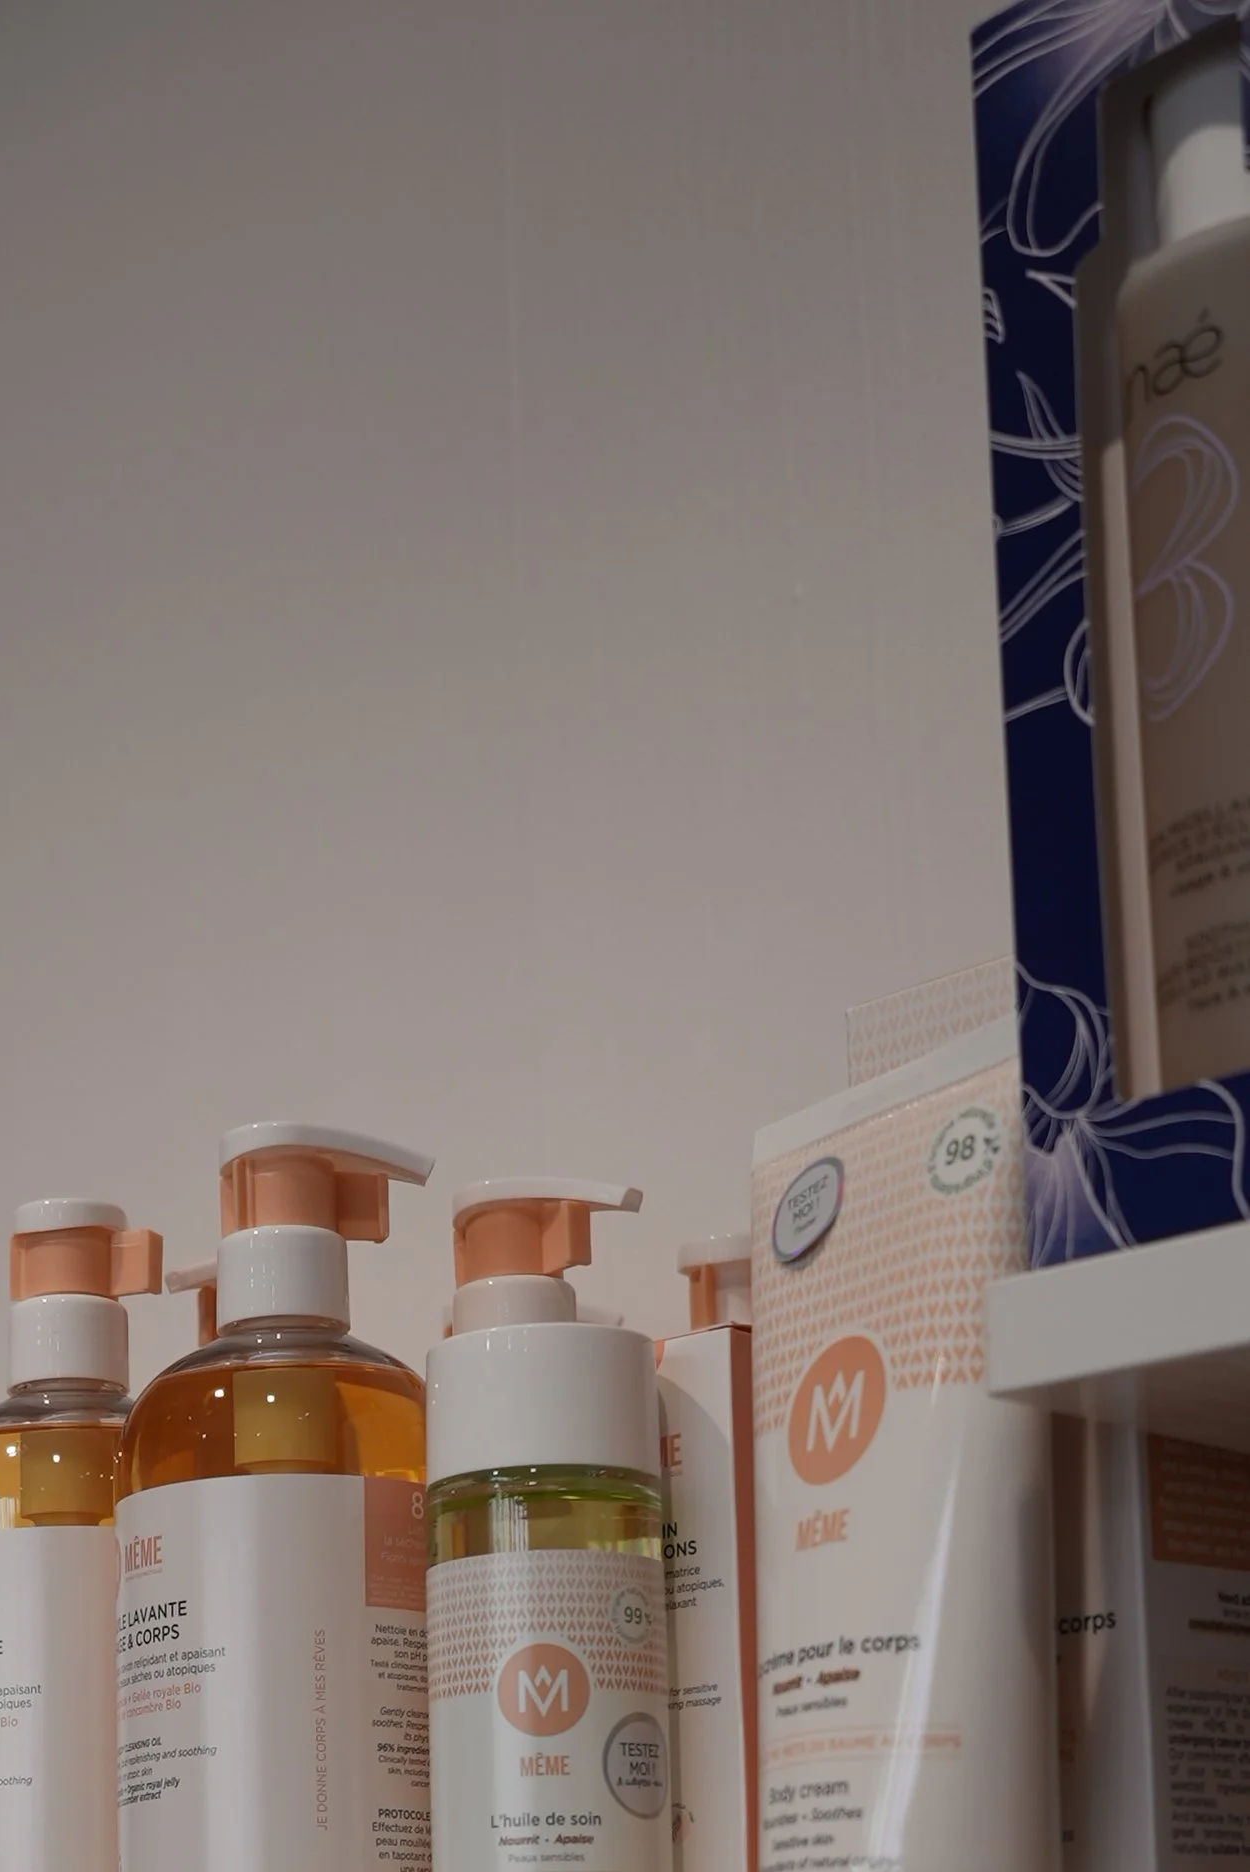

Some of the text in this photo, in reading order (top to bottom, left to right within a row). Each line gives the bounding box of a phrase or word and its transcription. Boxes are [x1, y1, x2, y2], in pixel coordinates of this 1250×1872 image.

[788, 1174, 829, 1211] TESTEZ
[795, 1508, 851, 1552] MÊME
[124, 1535, 163, 1575] MÊME
[128, 1600, 188, 1627] LAVANTE
[1058, 1610, 1117, 1635] corps
[135, 1624, 180, 1648] CORPS
[169, 1646, 226, 1662] et apaisant
[798, 1634, 922, 1667] pour le corps
[154, 1663, 217, 1679] ou atopiques
[152, 1683, 202, 1700] royale Bio
[0, 1716, 18, 1729] Bio
[313, 1628, 328, 1831] JE DONNE CORPS MES RÊVES
[619, 1742, 660, 1759] TESTEZ
[520, 1752, 571, 1777] MÊME
[799, 1779, 849, 1800] cream
[371, 1822, 413, 1835] Effectuez
[490, 1810, 602, 1829] L'huile de soin
